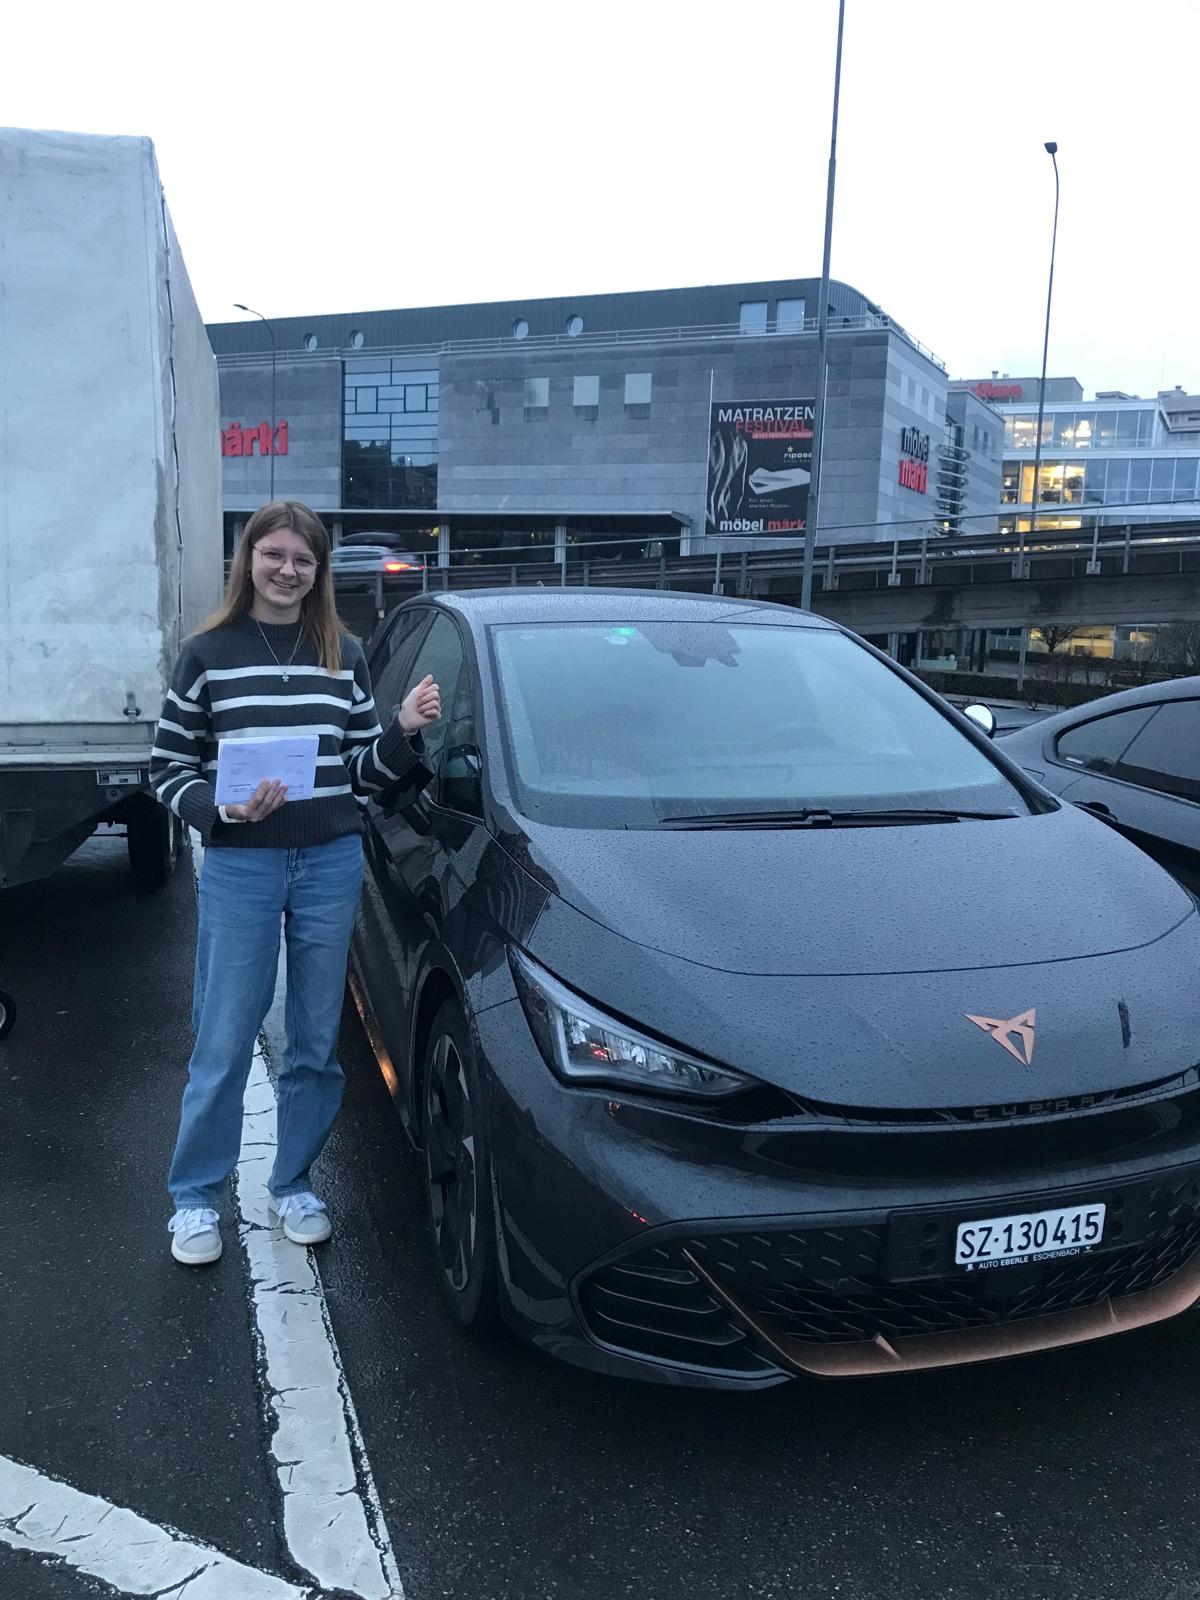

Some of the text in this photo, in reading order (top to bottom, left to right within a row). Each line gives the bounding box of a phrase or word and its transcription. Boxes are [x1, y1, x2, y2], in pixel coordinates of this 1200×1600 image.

[718, 406, 815, 422] MATRATZEN
[736, 419, 811, 433] FESTIVAL
[220, 419, 288, 456] ärki
[719, 518, 806, 532] möbel märk
[974, 1096, 1094, 1118] CUPRA
[978, 1248, 1081, 1269] AUTO EBERLE ESCHENBACH
